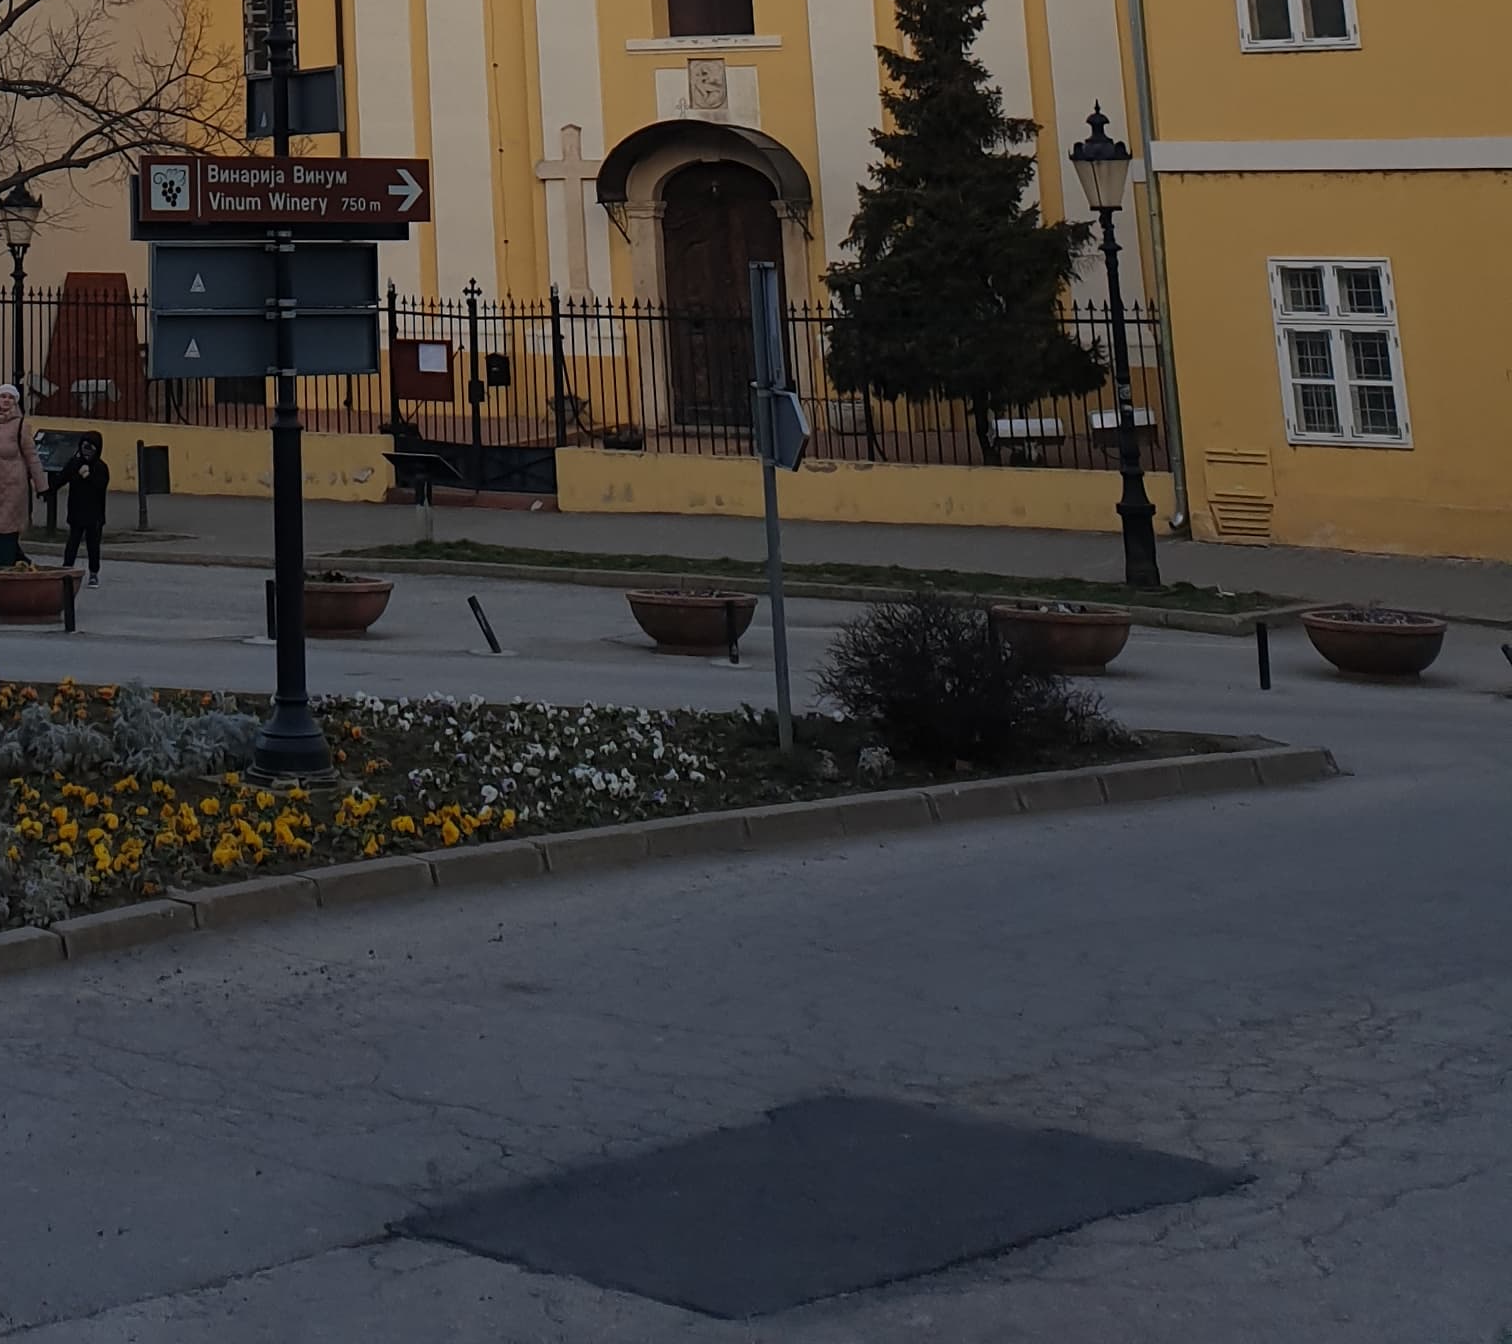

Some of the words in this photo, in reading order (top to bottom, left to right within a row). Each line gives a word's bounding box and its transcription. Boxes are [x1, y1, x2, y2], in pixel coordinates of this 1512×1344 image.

[207, 164, 285, 187] Винарија
[293, 166, 348, 188] Винум
[208, 192, 261, 211] Vinum
[268, 192, 328, 216] Winery
[341, 198, 366, 212] 750
[369, 201, 381, 212] m
